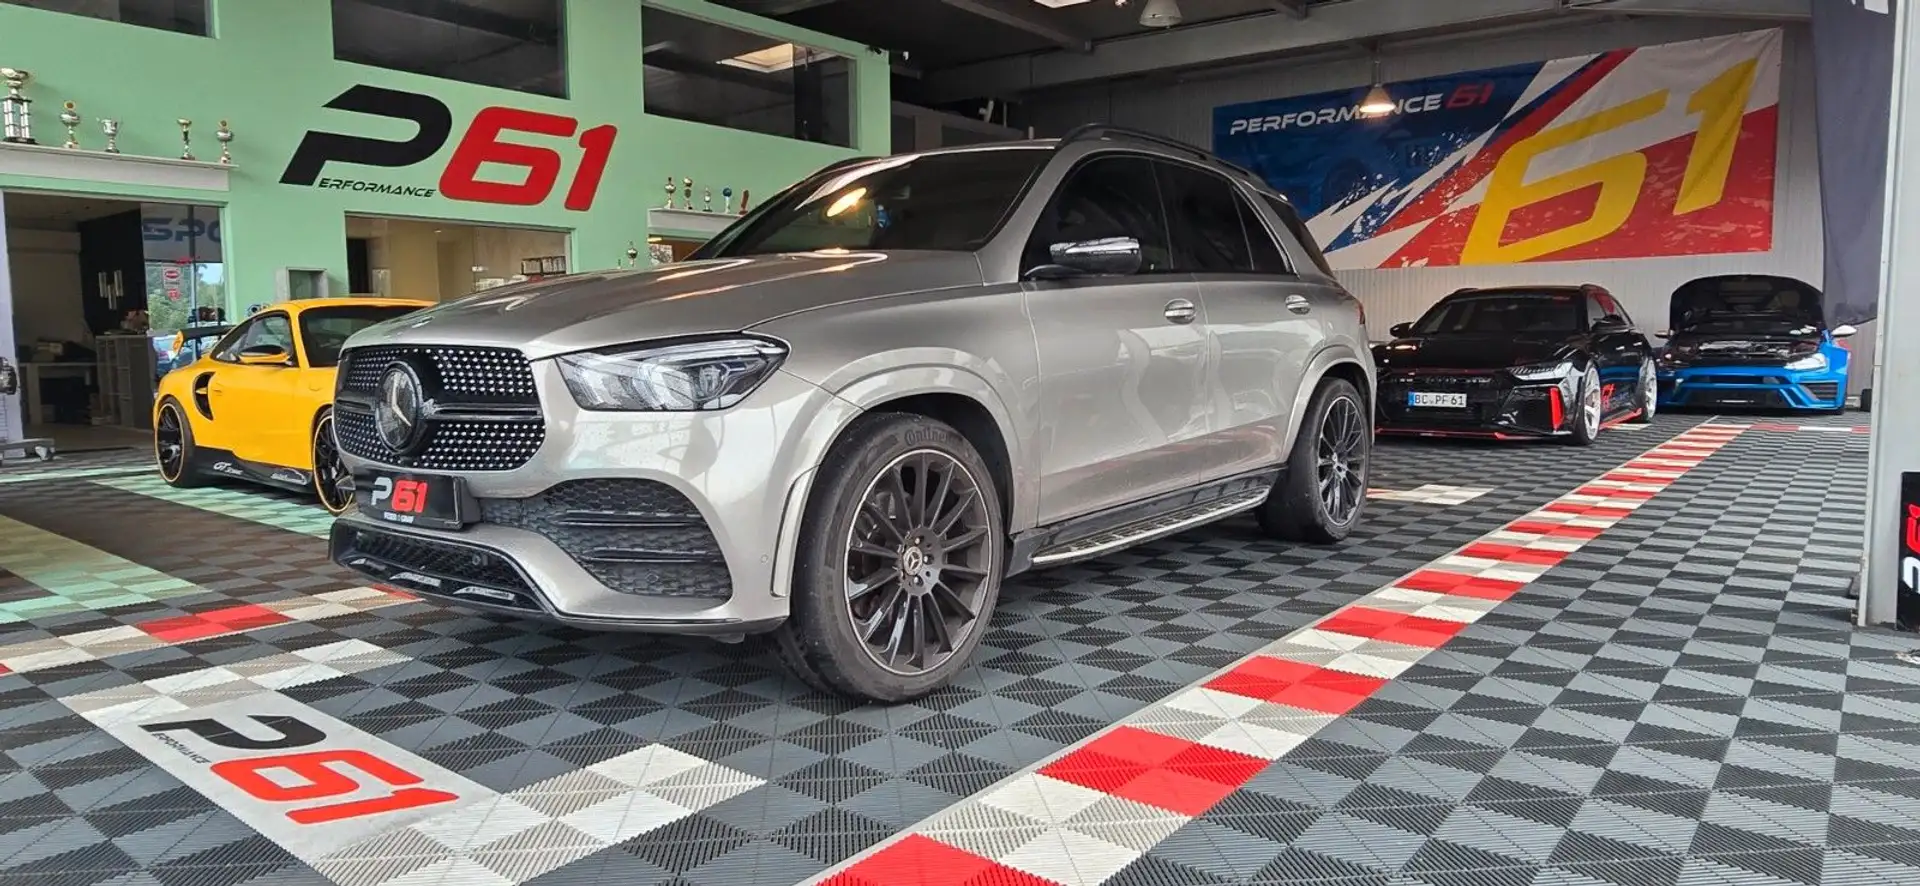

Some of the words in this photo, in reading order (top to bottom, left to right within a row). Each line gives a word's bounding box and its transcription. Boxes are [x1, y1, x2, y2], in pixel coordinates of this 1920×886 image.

[1230, 93, 1444, 136] PERFORMNCE
[1447, 81, 1495, 109] 61
[1460, 57, 1758, 265] 61
[371, 476, 428, 513] P61
